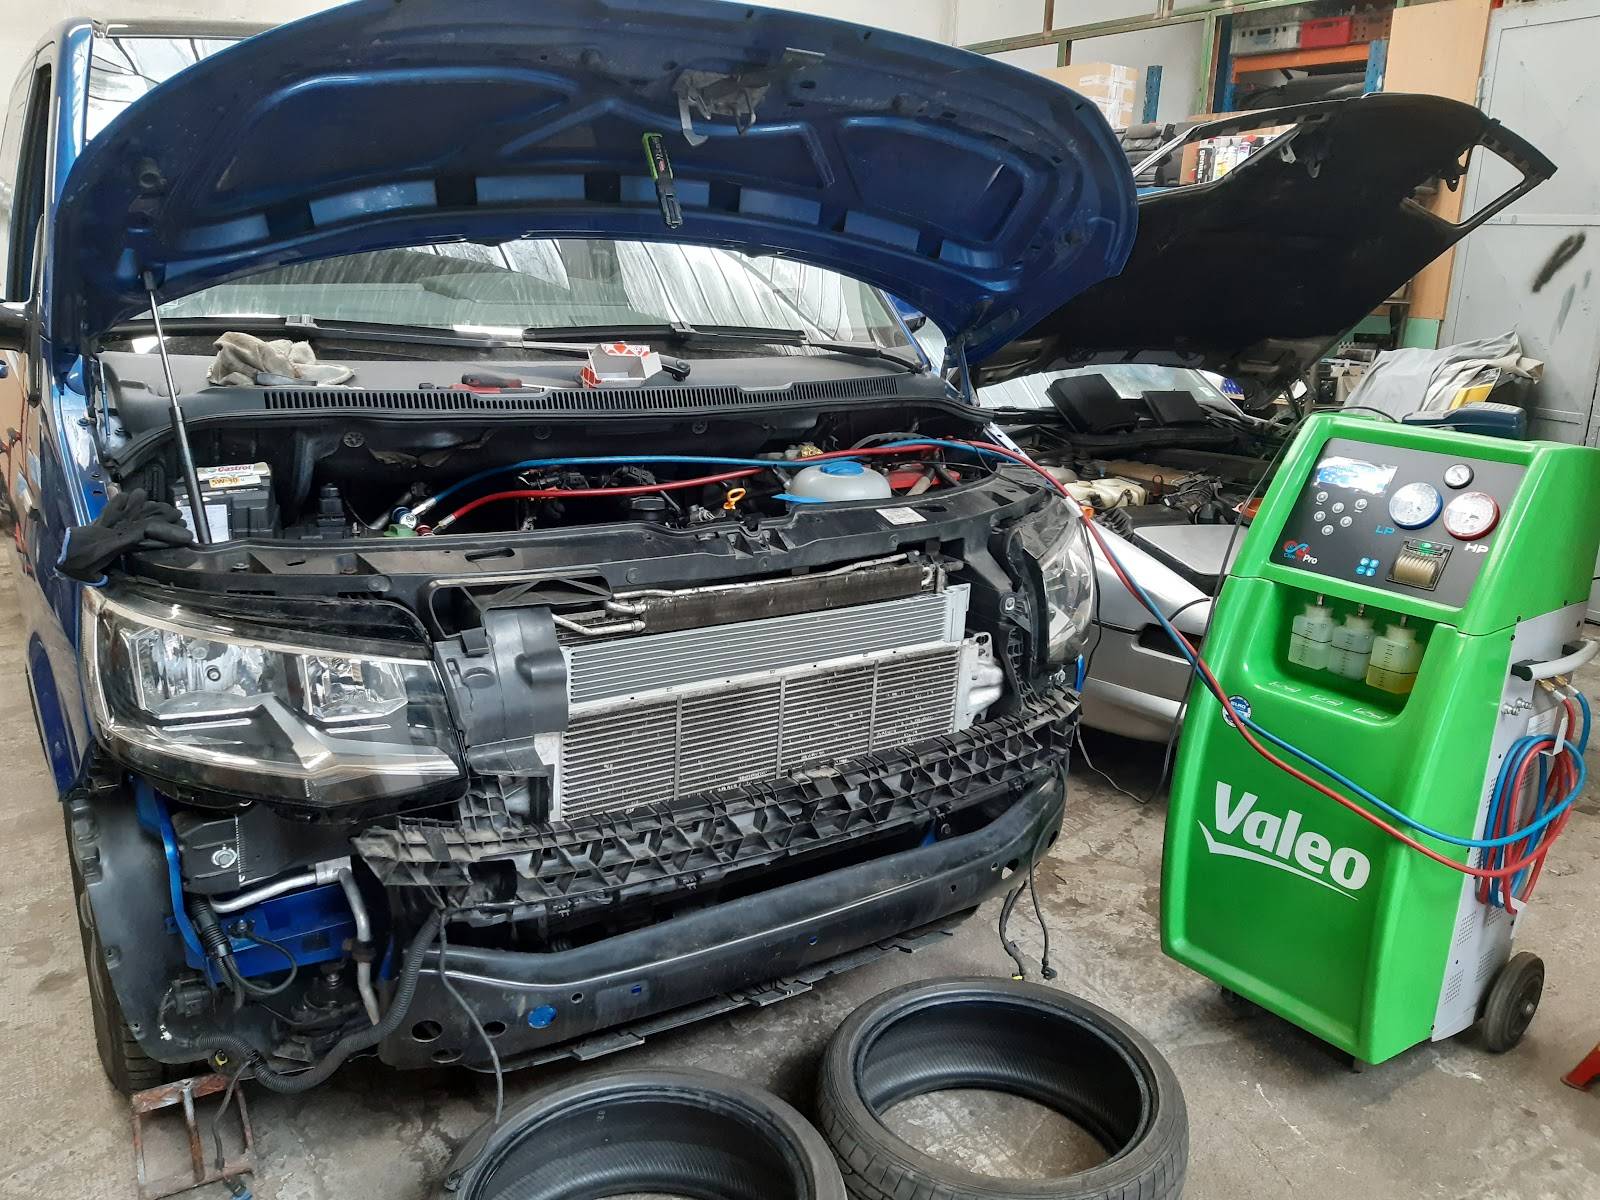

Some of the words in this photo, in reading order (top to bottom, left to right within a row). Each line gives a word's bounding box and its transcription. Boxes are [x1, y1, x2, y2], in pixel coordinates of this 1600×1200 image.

[1464, 543, 1489, 553] HP
[1302, 554, 1318, 565] Pro
[1215, 780, 1371, 890] Valeo
